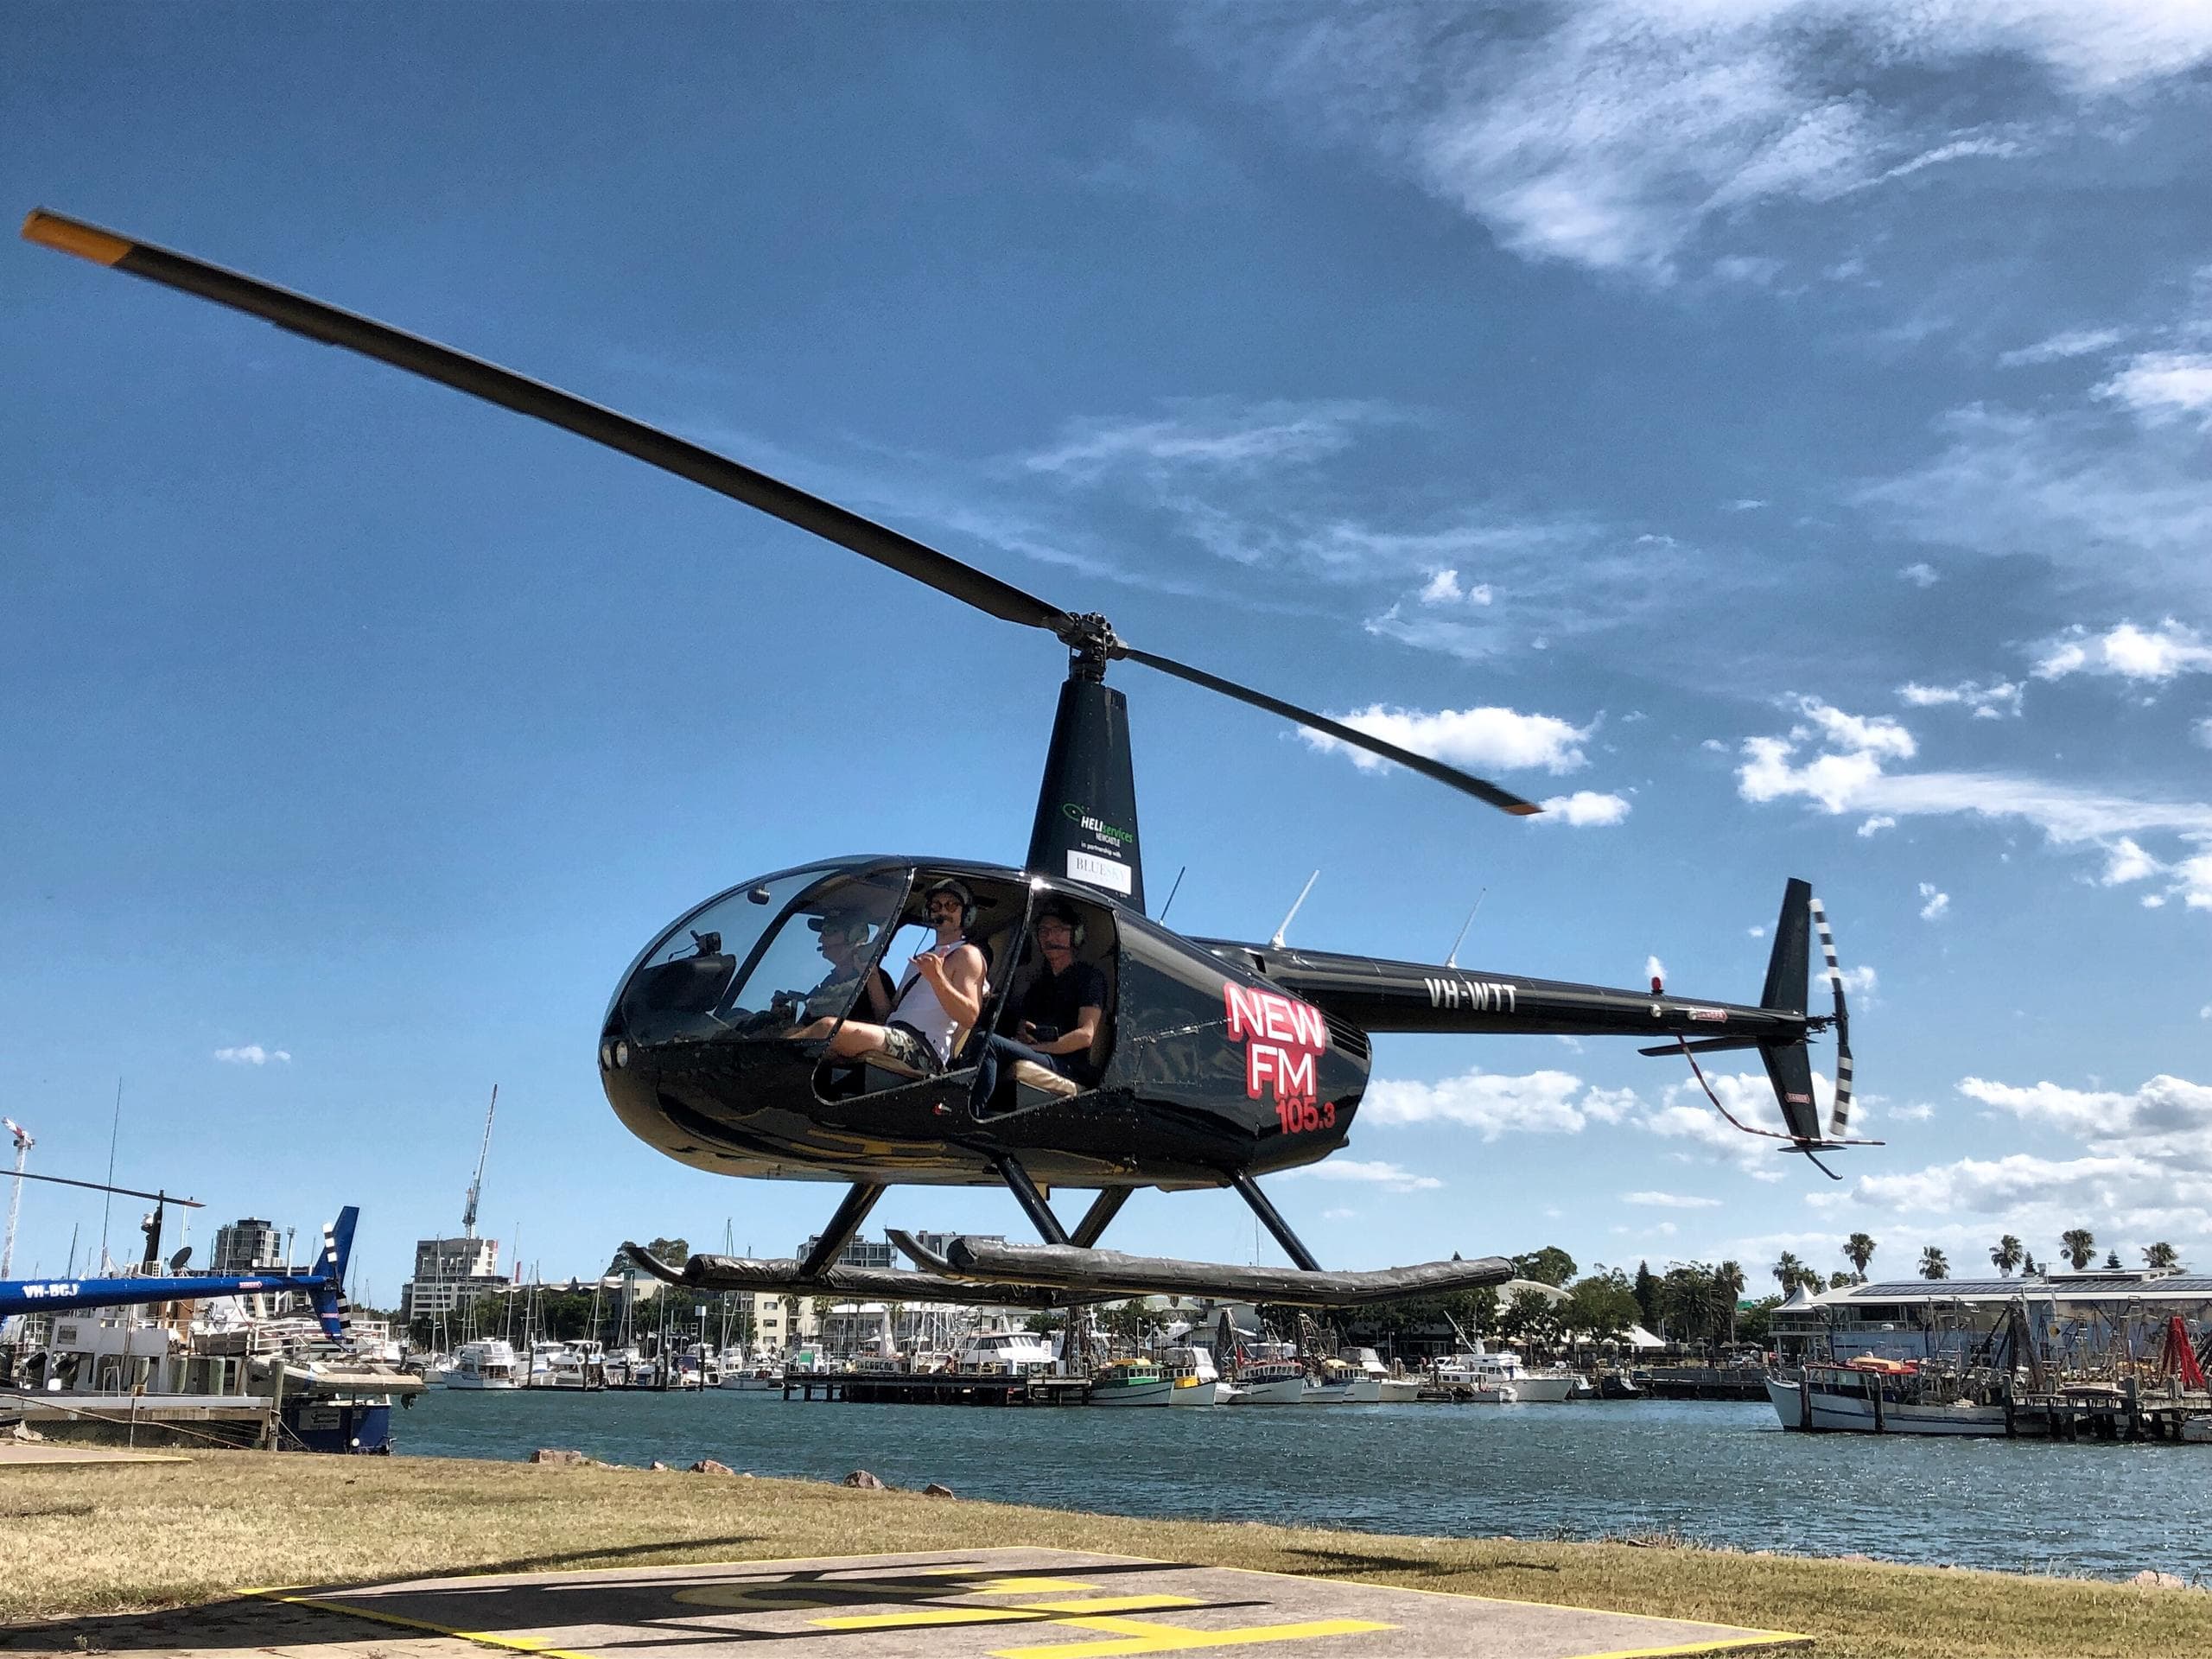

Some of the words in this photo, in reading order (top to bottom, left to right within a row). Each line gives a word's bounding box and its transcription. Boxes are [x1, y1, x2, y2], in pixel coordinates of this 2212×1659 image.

[1228, 986, 1324, 1050] NEW
[1424, 977, 1517, 1013] VH-WTT
[1251, 1042, 1313, 1096] FM
[1275, 1096, 1337, 1135] 105.3
